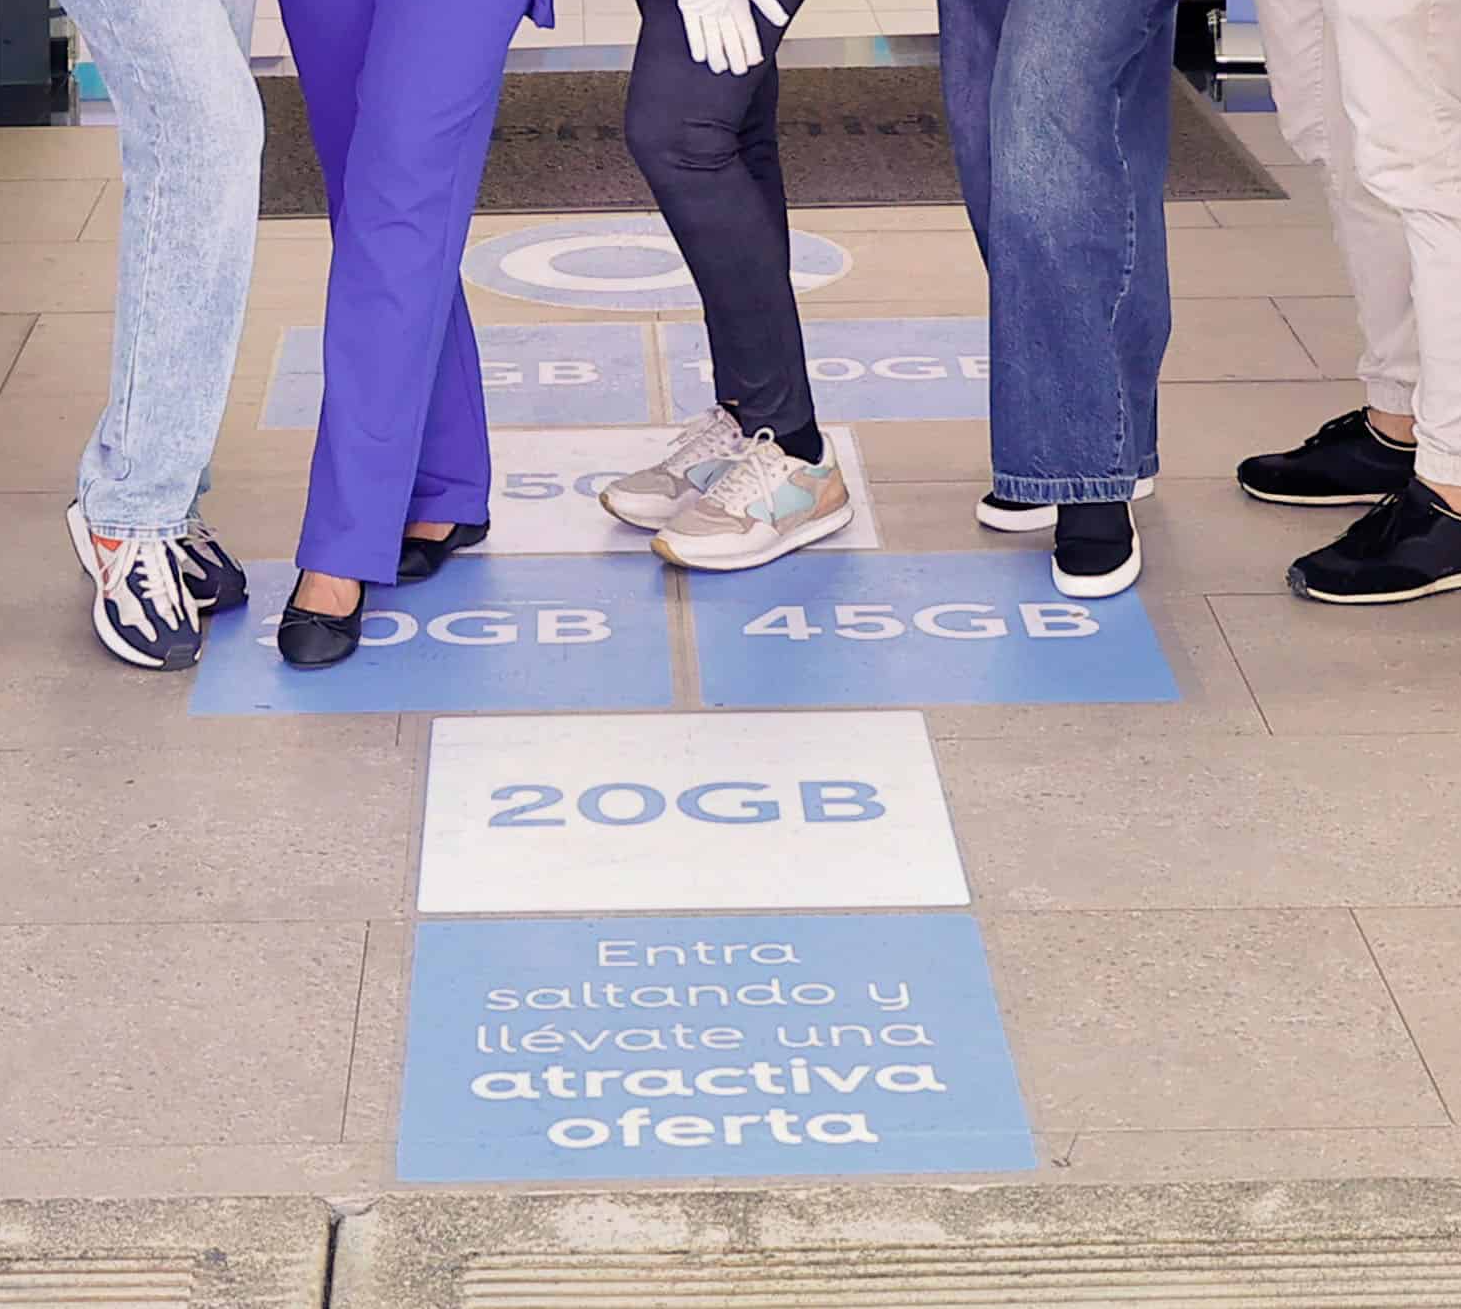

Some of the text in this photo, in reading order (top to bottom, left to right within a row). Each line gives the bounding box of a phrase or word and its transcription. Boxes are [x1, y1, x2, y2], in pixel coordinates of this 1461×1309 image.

[743, 603, 1102, 641] 45GB
[488, 780, 887, 828] 20GB
[597, 939, 802, 967] Entra
[484, 977, 912, 1011] saltando y
[476, 1022, 935, 1054] llévate una
[471, 1059, 947, 1101] atractiva
[546, 1107, 879, 1149] oferta
